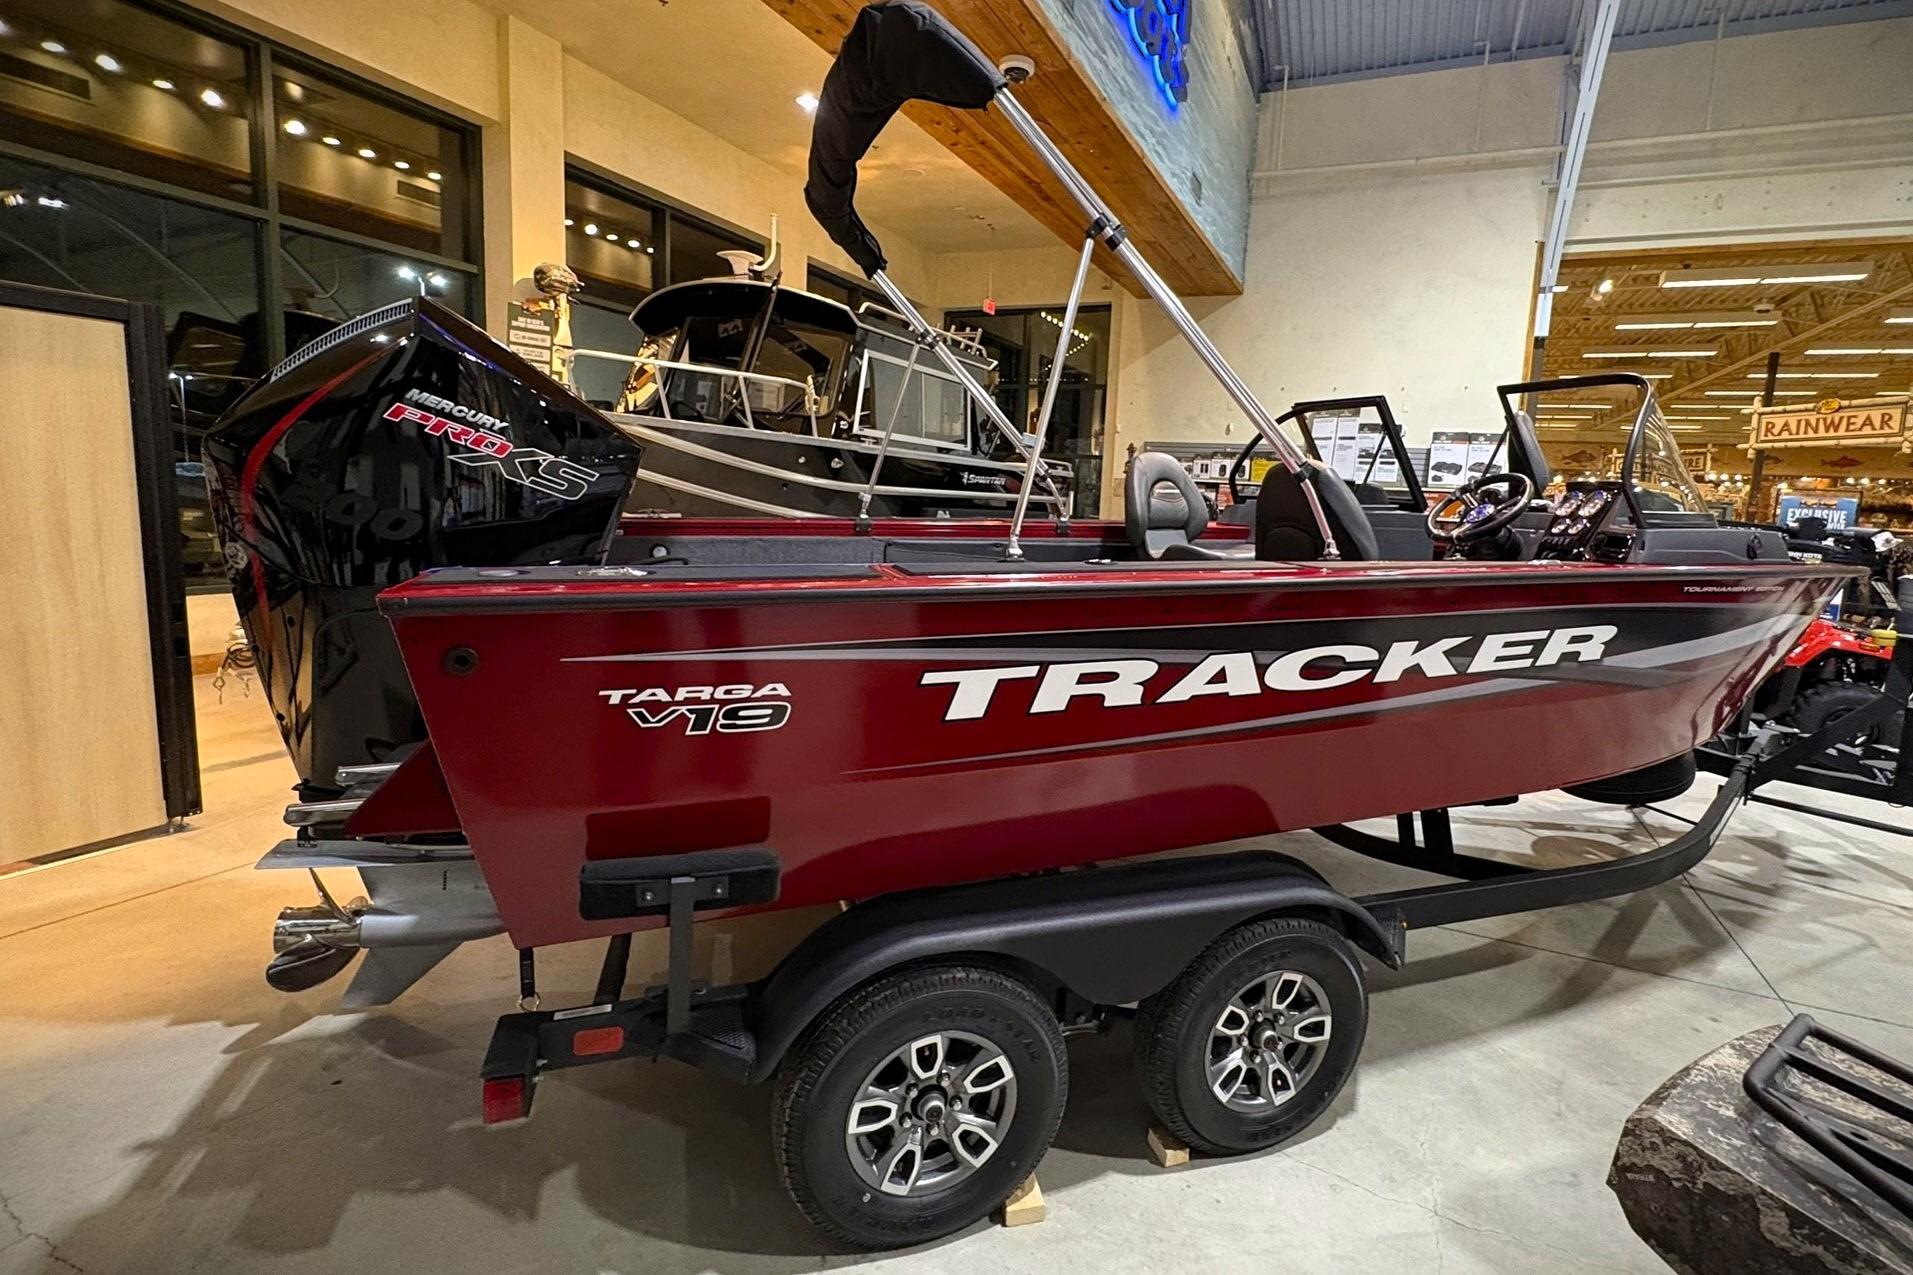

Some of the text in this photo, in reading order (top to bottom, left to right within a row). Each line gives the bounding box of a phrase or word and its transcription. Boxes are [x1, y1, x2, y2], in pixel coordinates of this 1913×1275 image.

[405, 388, 509, 432] MERCURY
[1763, 412, 1894, 438] RAINWEAR
[383, 402, 600, 500] PRO XS
[1786, 508, 1848, 524] EXCLUSIVE
[920, 624, 1618, 721] TRACKER
[598, 683, 792, 705] TARGA
[626, 701, 792, 736] V19
